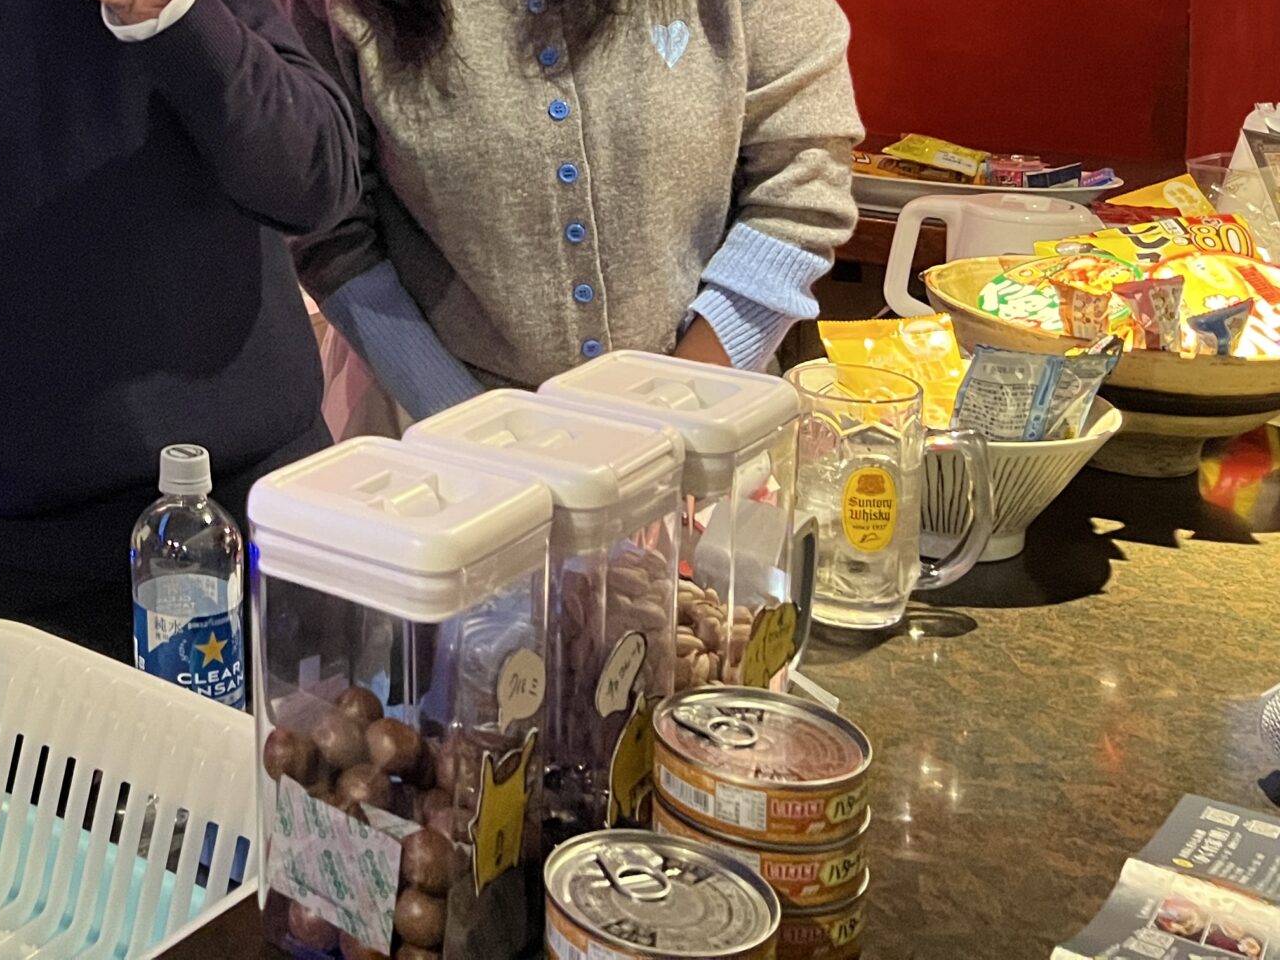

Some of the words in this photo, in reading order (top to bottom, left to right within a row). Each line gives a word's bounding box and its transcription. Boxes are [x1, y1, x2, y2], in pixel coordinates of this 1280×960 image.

[848, 496, 892, 509] Suntory
[849, 509, 891, 522] Whisky
[177, 661, 241, 685] CLEAR
